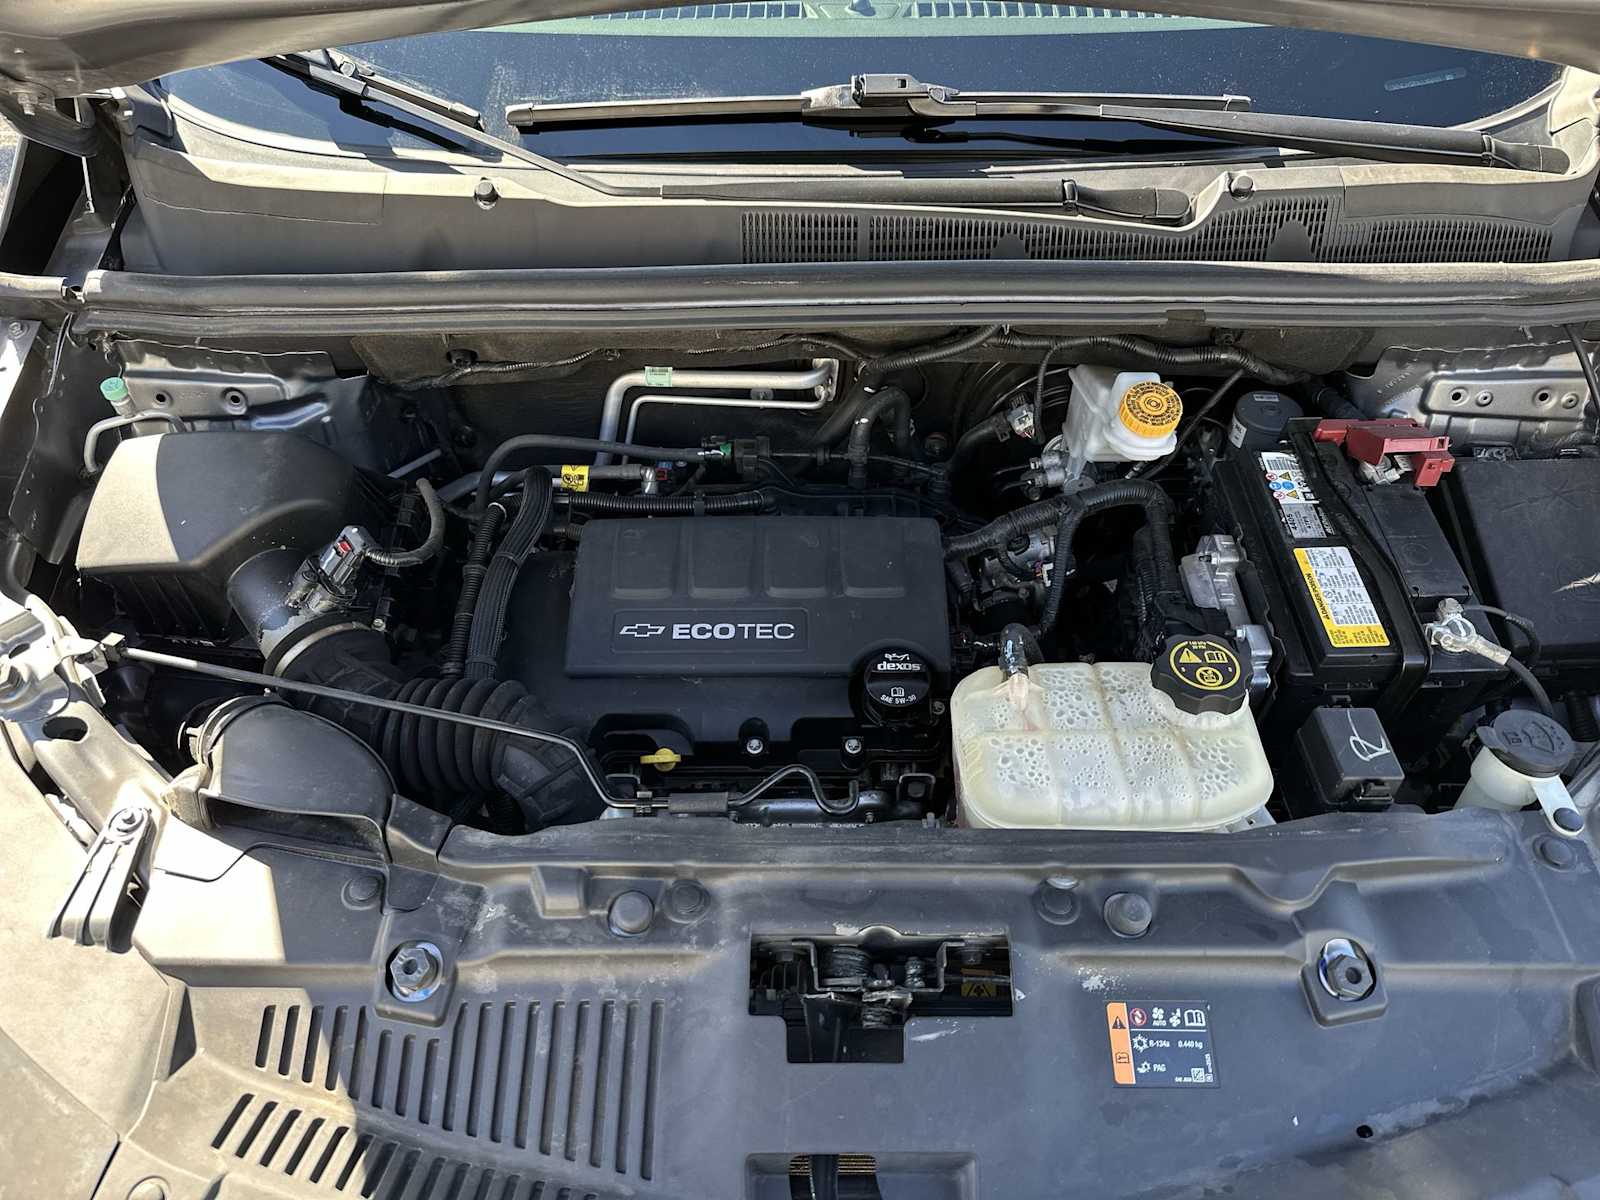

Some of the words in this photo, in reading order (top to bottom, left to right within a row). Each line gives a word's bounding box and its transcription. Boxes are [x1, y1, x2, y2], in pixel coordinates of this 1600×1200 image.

[672, 623, 795, 640] ECOTEC
[877, 661, 921, 671] dexos
[880, 694, 894, 704] SAE
[1149, 1039, 1170, 1048] R-134a
[1153, 1063, 1167, 1072] PAG
